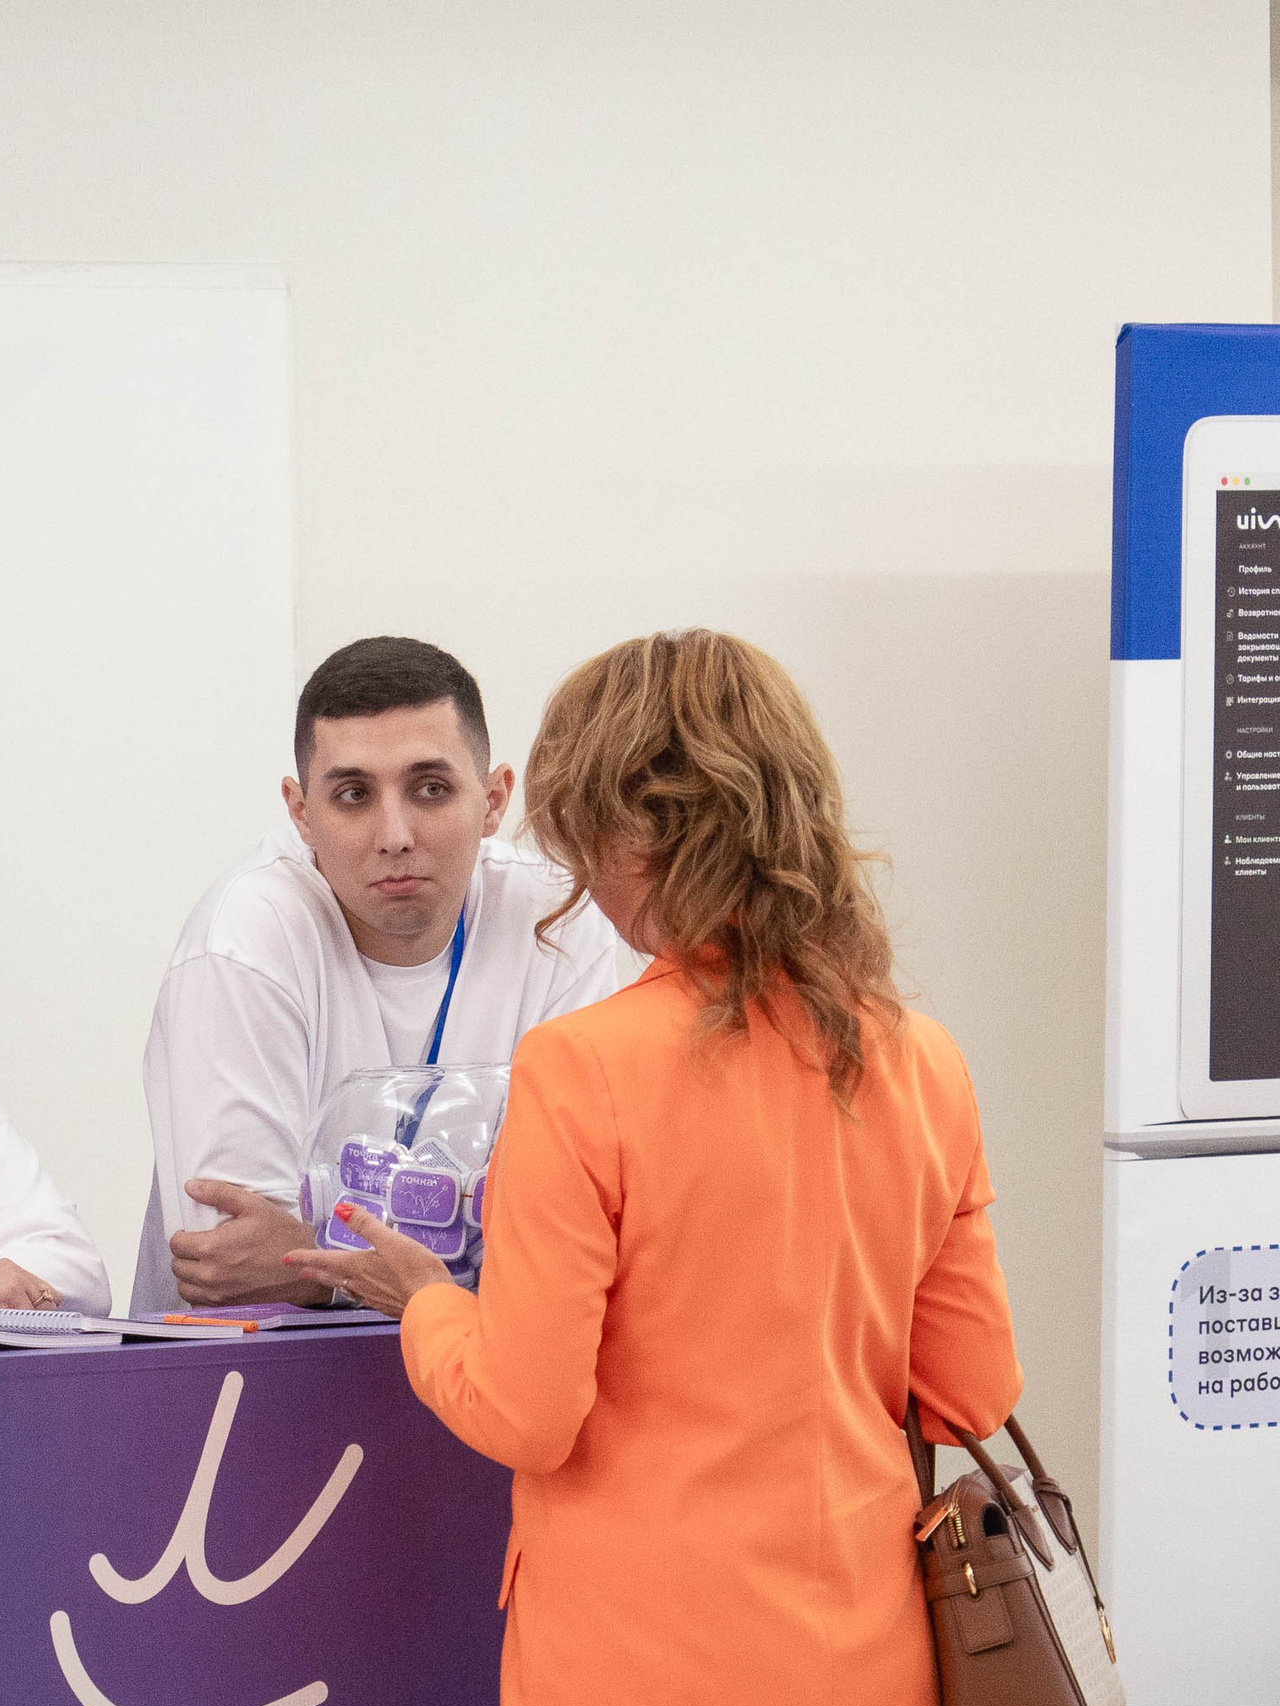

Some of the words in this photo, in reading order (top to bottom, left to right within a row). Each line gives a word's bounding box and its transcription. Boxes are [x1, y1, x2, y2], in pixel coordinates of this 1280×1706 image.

[1238, 564, 1272, 575] Профиль
[1238, 587, 1270, 597] История
[1237, 631, 1279, 641] Ведомости
[1237, 654, 1279, 664] документы
[1237, 674, 1267, 684] Тарифы
[1236, 750, 1263, 759] Общие
[1235, 835, 1252, 844] Мои
[1235, 868, 1267, 876] клиенты
[400, 1174, 435, 1187] точка
[1199, 1285, 1263, 1305] Из-за
[1269, 1286, 1280, 1301] з
[1198, 1346, 1280, 1365] возмож
[1198, 1379, 1224, 1395] на
[1230, 1371, 1280, 1398] рабо
